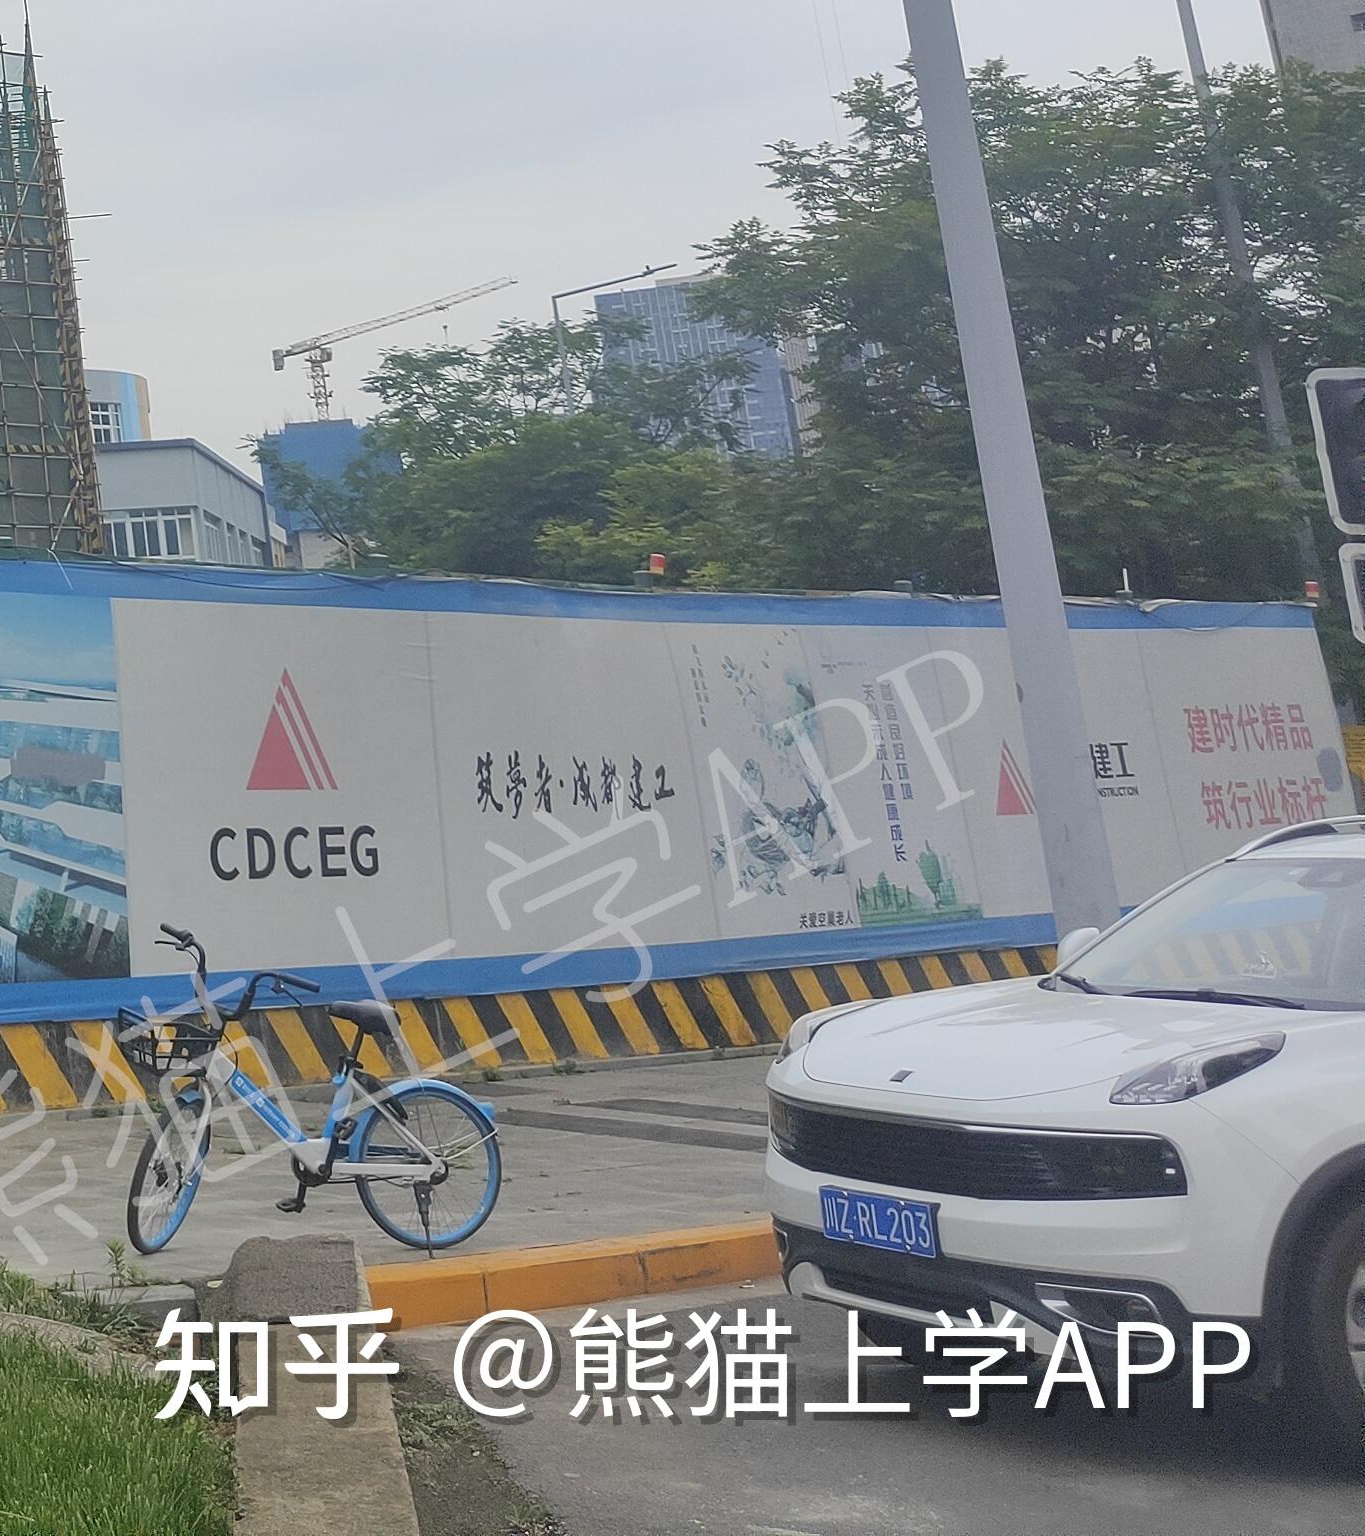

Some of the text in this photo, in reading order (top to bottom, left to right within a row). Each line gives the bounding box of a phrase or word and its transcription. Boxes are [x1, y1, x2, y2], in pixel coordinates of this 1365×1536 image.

[1183, 702, 1314, 754] 建时代精品
[1089, 742, 1135, 779] 建工
[1201, 776, 1327, 830] 筑行业标杆
[210, 825, 379, 881] CDCEG
